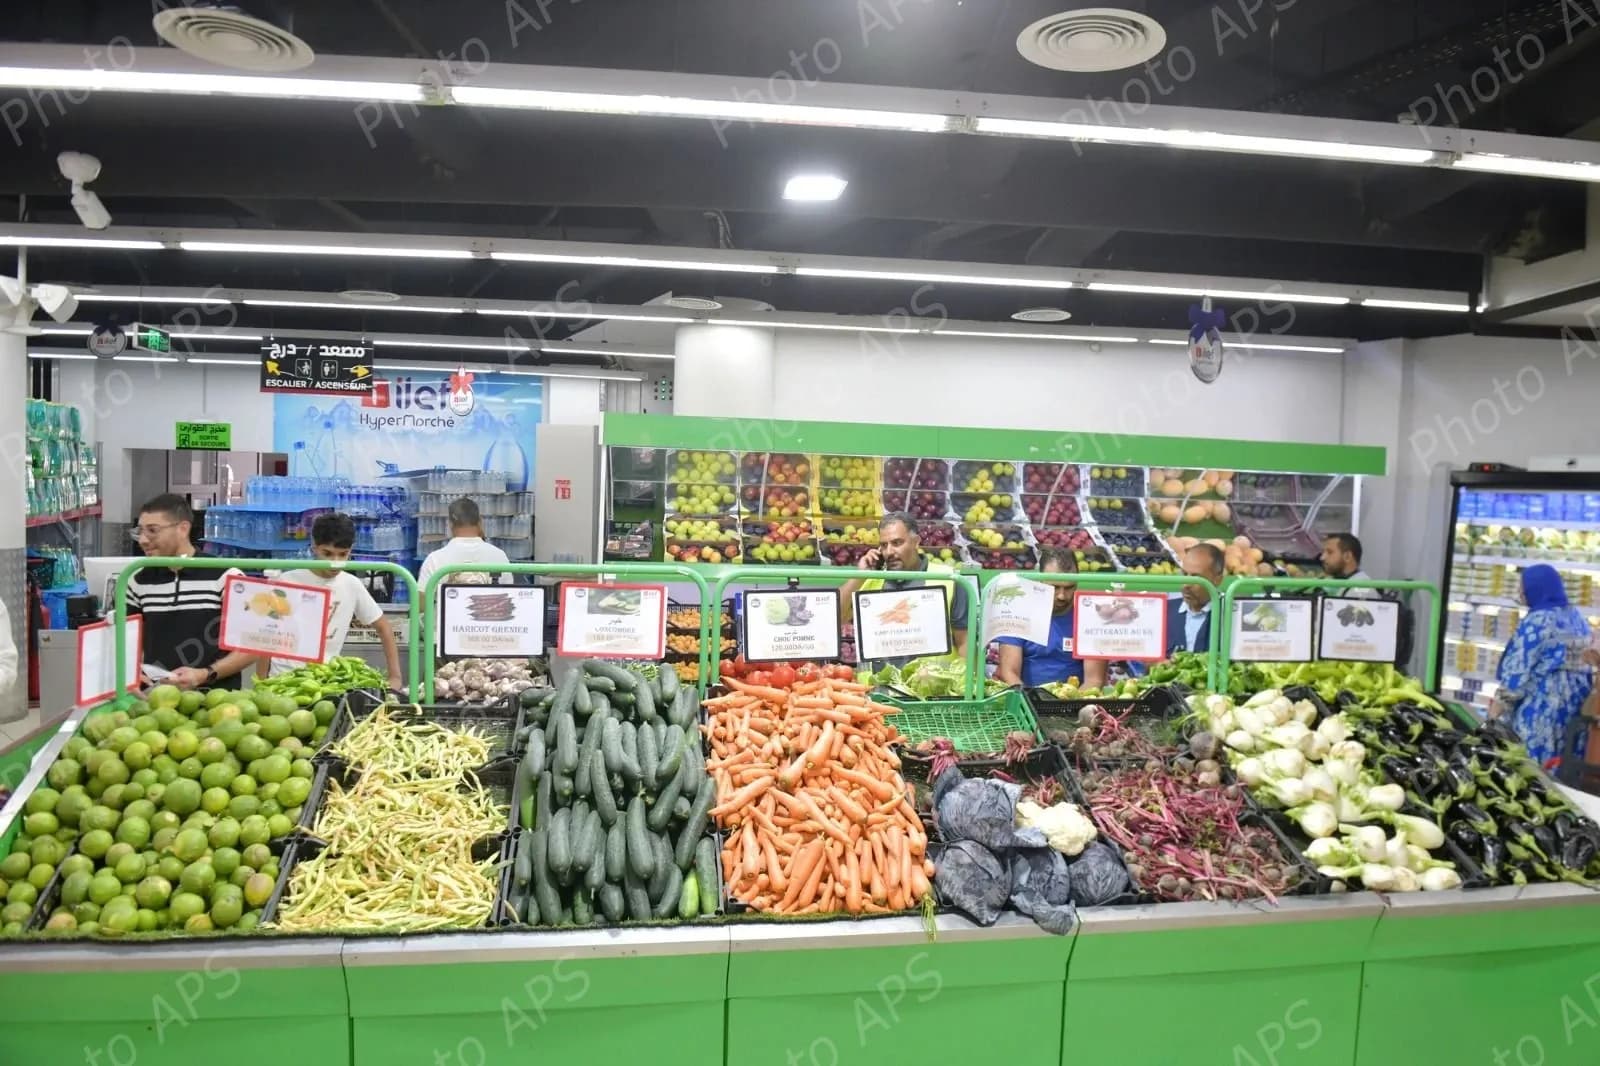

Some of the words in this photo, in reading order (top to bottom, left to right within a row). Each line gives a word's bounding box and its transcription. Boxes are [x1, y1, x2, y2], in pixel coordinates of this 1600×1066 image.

[270, 343, 297, 359] درج
[319, 345, 365, 358] مصعد
[265, 379, 306, 388] ESCALIER
[315, 381, 367, 391] ASCENSEUR
[452, 625, 490, 633] HARICOT
[491, 625, 529, 634] GRENIER
